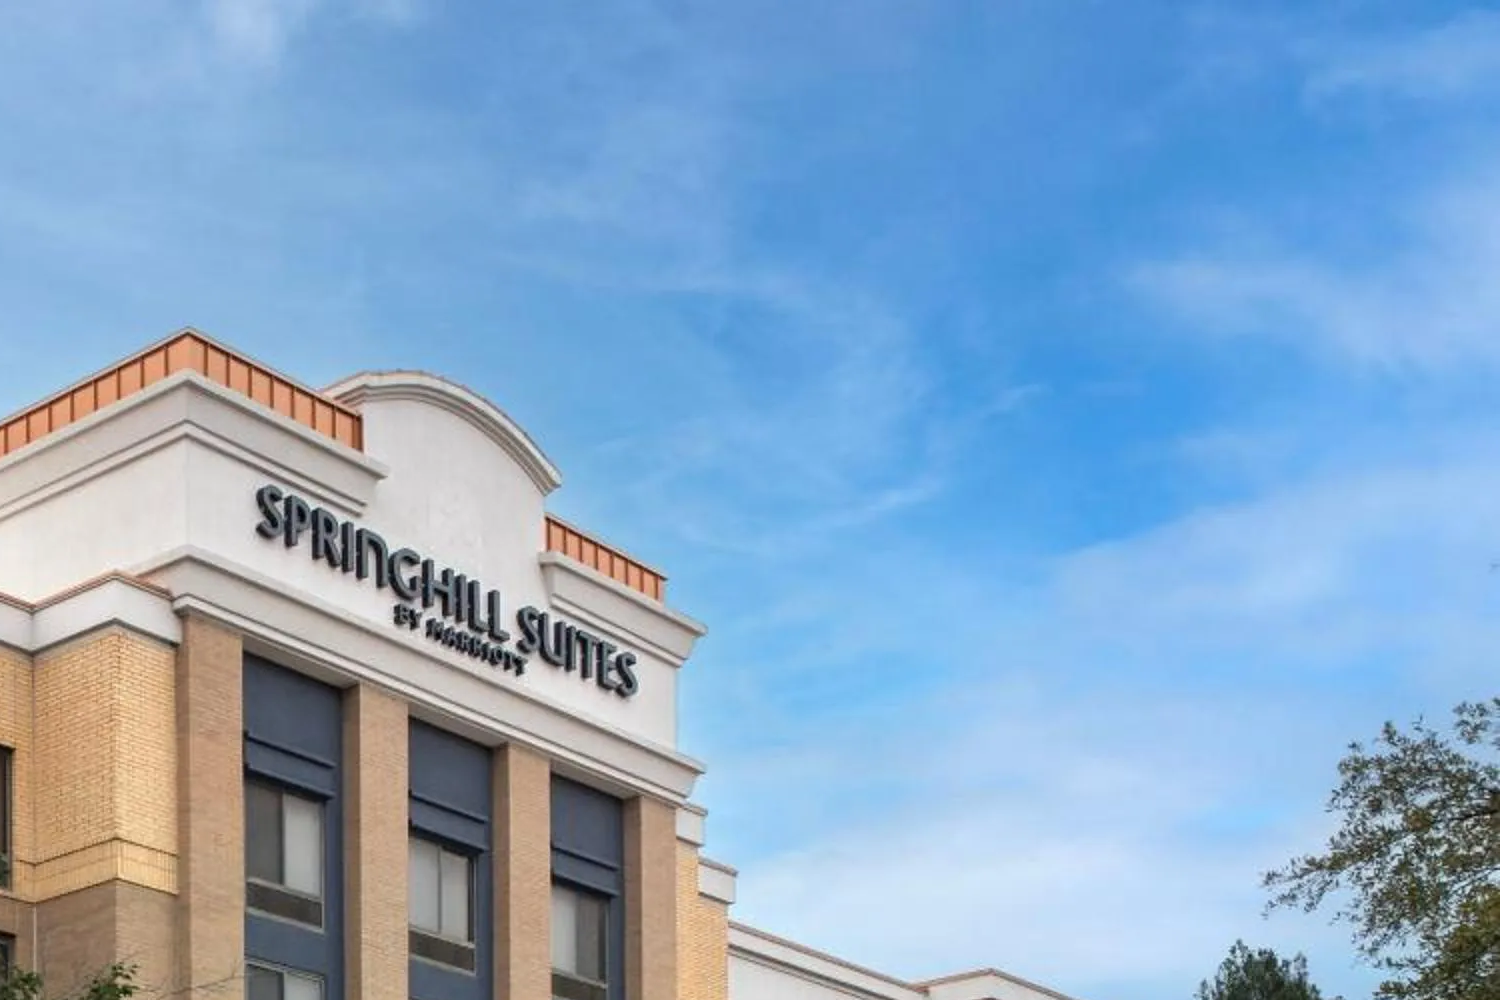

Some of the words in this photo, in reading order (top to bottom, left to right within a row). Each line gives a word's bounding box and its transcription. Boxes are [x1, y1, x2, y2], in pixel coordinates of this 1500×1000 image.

[256, 484, 510, 641] SPRINGHILL
[517, 605, 638, 698] SUITES
[393, 603, 422, 630] BY
[425, 617, 528, 677] MARRIOTT
